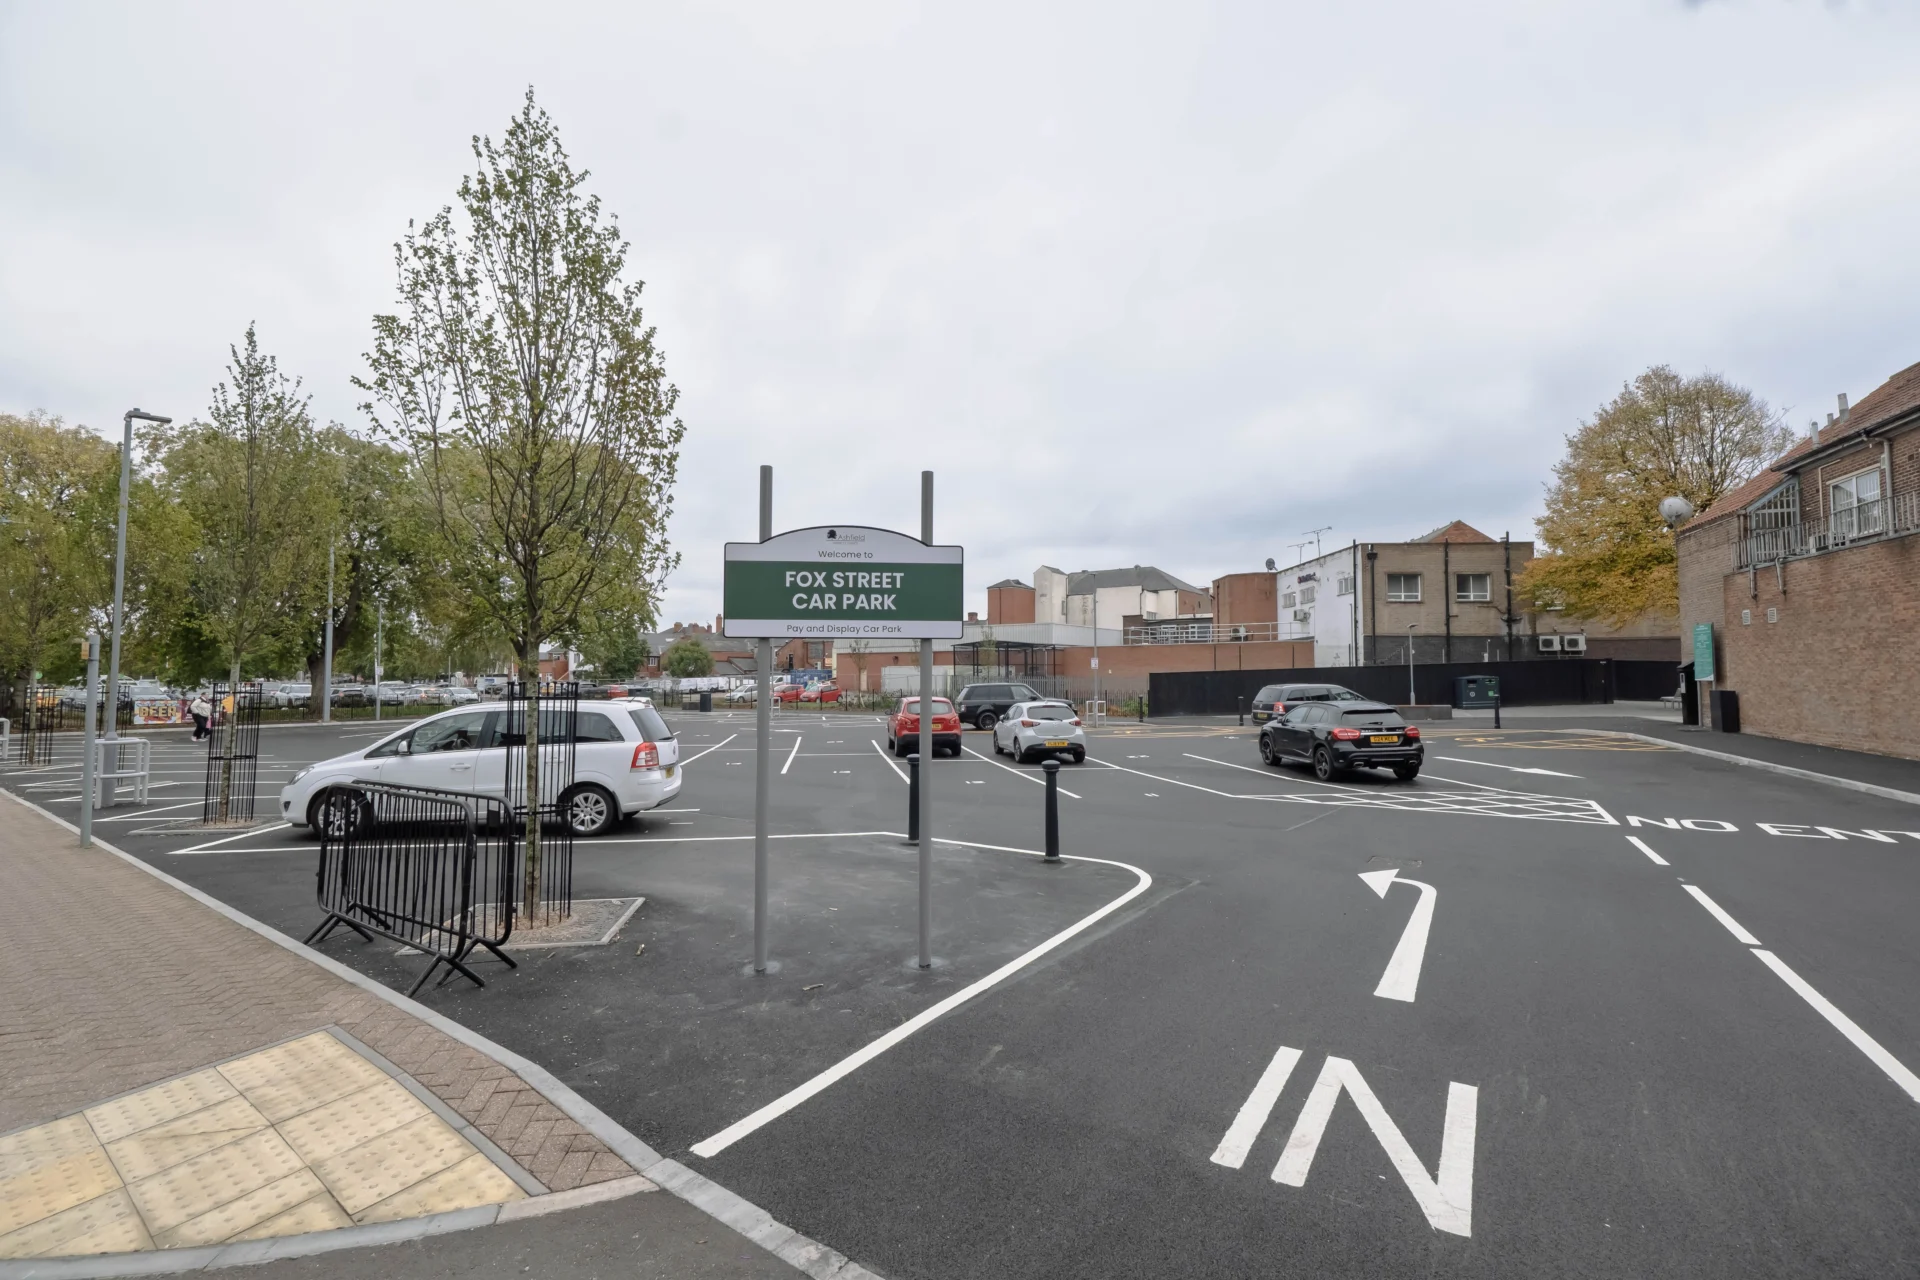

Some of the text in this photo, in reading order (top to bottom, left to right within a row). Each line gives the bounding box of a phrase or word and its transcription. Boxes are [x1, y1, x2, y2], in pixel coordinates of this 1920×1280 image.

[818, 550, 874, 559] Welcome to
[785, 571, 905, 589] FOX STREET
[792, 593, 897, 610] CAR PARK
[786, 625, 804, 634] Pay
[805, 625, 824, 633] and
[826, 625, 860, 635] Display
[139, 706, 177, 717] BEER
[1625, 815, 1740, 832] NO
[1209, 1045, 1478, 1238] IN
